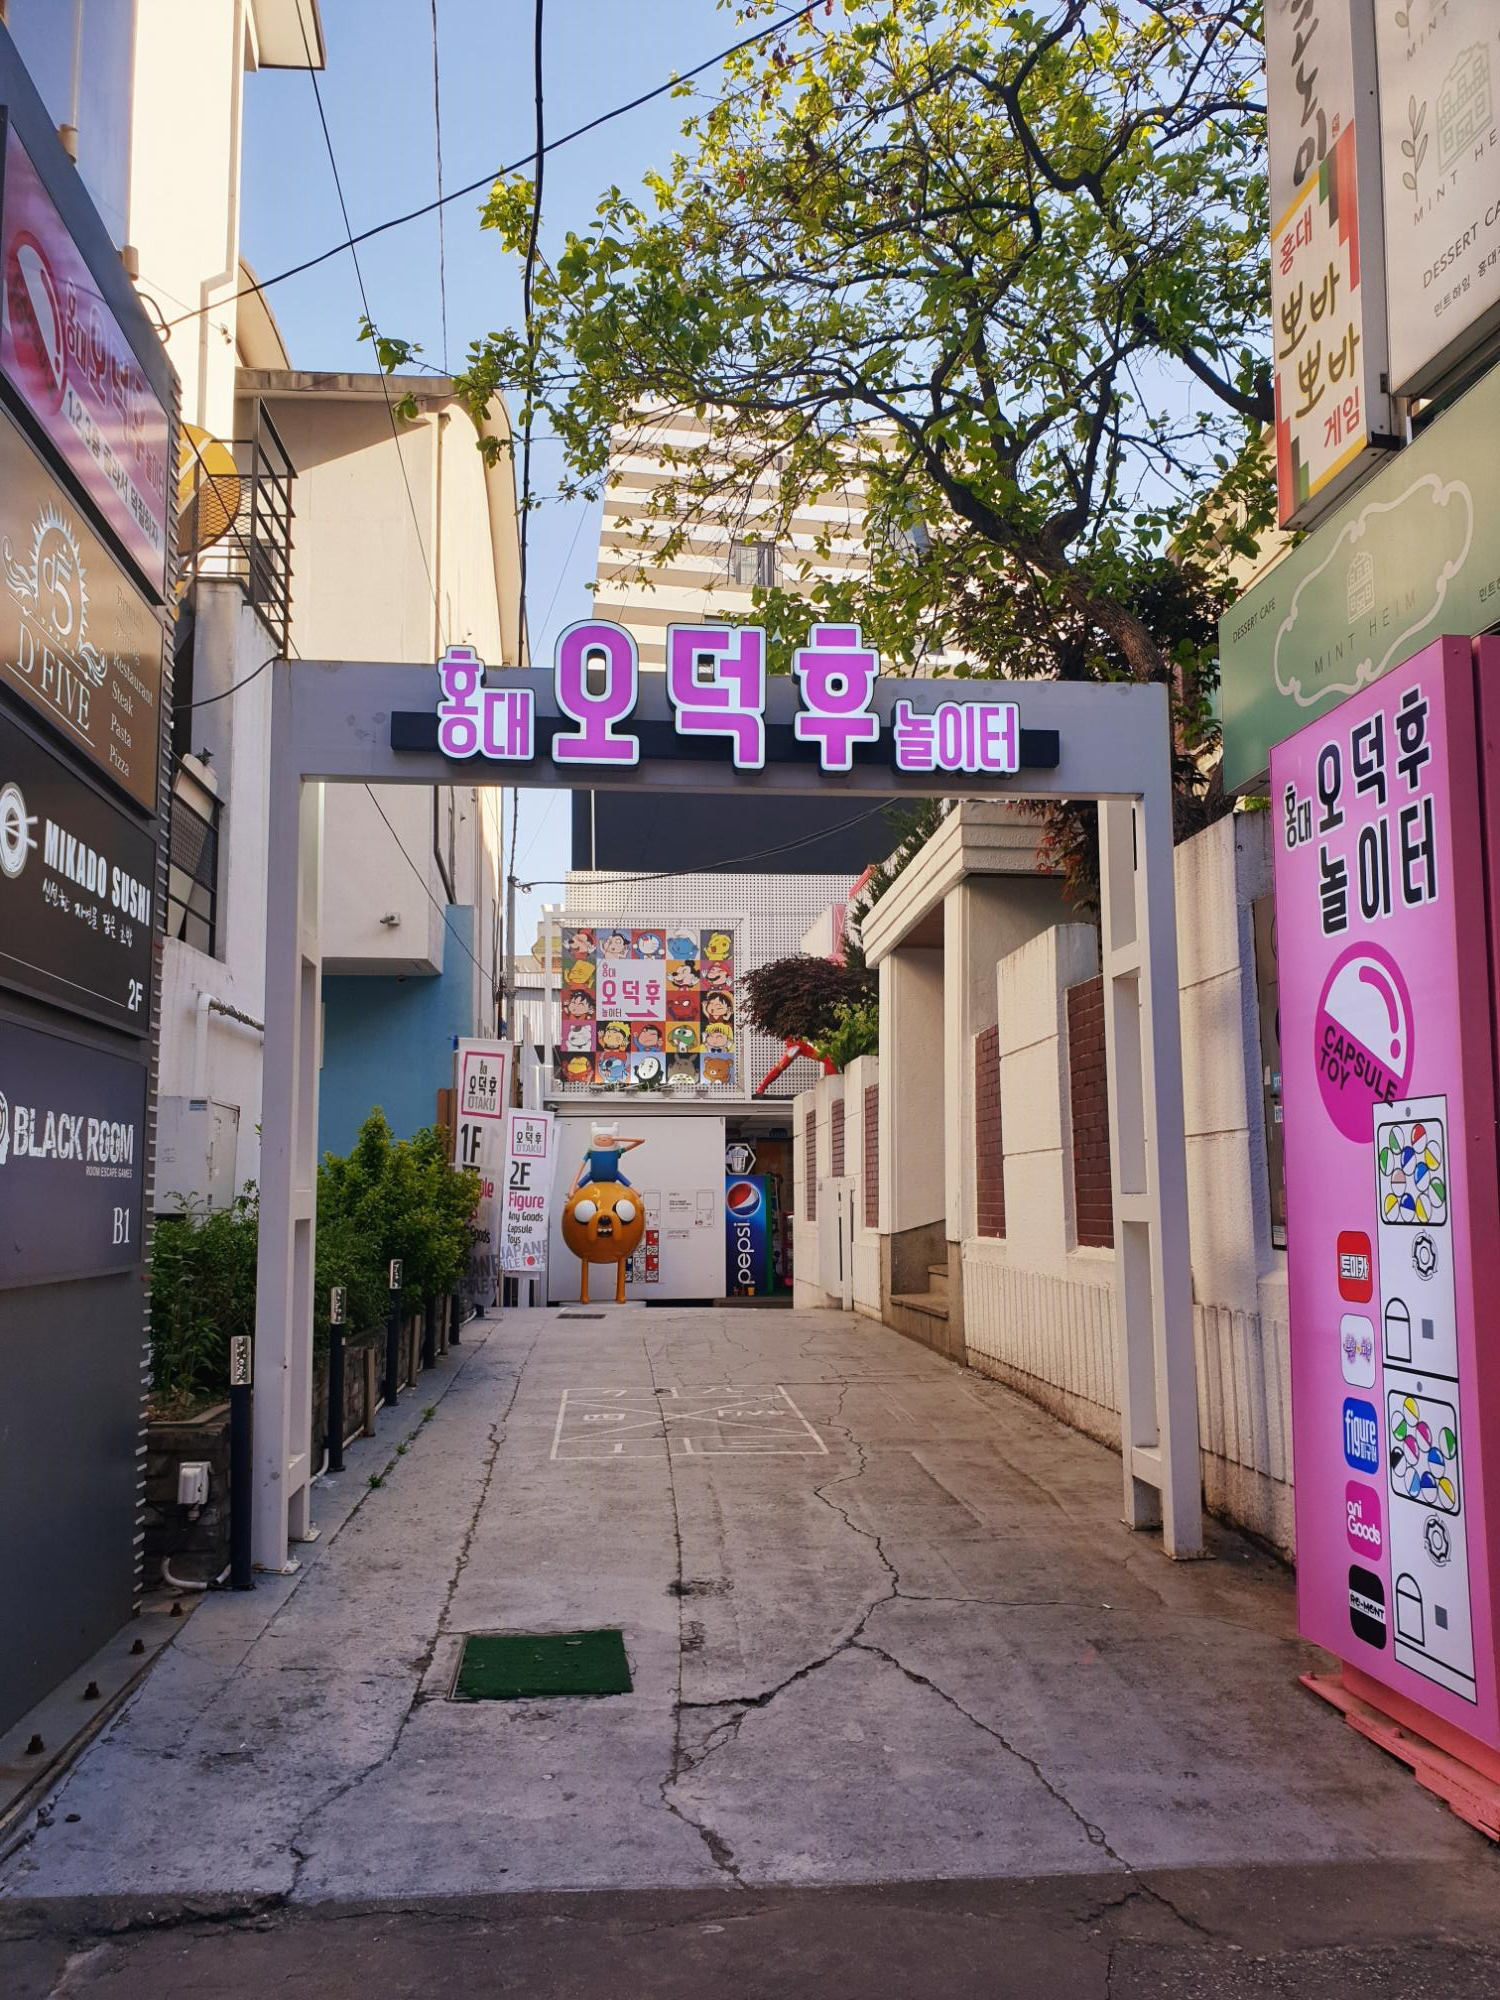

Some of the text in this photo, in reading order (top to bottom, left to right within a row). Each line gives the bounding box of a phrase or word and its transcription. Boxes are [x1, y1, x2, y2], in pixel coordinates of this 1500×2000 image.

[1413, 169, 1459, 227] MINT
[1279, 204, 1312, 275] 홍대
[1423, 221, 1479, 290] DESSERT
[1433, 273, 1471, 318] 민트하임
[1323, 385, 1361, 449] 게임
[1232, 599, 1276, 644] DESSERT CAFE
[1314, 588, 1416, 676] MINT HEIM
[17, 621, 91, 731] D'FIVE
[113, 650, 154, 708] Restaurant
[439, 619, 1019, 771] 홍대 오덕후 놀이터
[111, 680, 134, 717] Steak
[110, 712, 132, 749] Pasta
[109, 743, 130, 778] Pizza
[1284, 687, 1431, 849] 홍대 오덕후
[44, 818, 151, 927] MIKADO SUSHI
[1319, 796, 1437, 936] 놀이터
[602, 962, 616, 978] 홍대
[127, 978, 144, 1013] 2F
[602, 980, 660, 1006] 오덕후
[602, 1007, 622, 1018] 놀이터
[469, 1075, 497, 1096] 오덕후
[1320, 1047, 1351, 1091] TOY
[1323, 1025, 1398, 1109] CAPSULE
[467, 1096, 496, 1112] OTAKU
[13, 1105, 133, 1164] BLACK ROOM
[461, 1123, 482, 1164] 1F
[517, 1131, 541, 1144] 오덕후
[517, 1143, 541, 1153] OTAKU
[86, 1166, 132, 1178] ROOM ESCAPE GAMES
[510, 1161, 531, 1185] 2F
[509, 1192, 544, 1211] Figure
[509, 1211, 543, 1222] Any Goods
[113, 1207, 130, 1244] B1
[507, 1234, 521, 1246] Toys
[508, 1223, 532, 1235] Capsule
[734, 1222, 755, 1284] pepsi
[1345, 1409, 1377, 1457] figure
[1347, 1514, 1381, 1546] Goods
